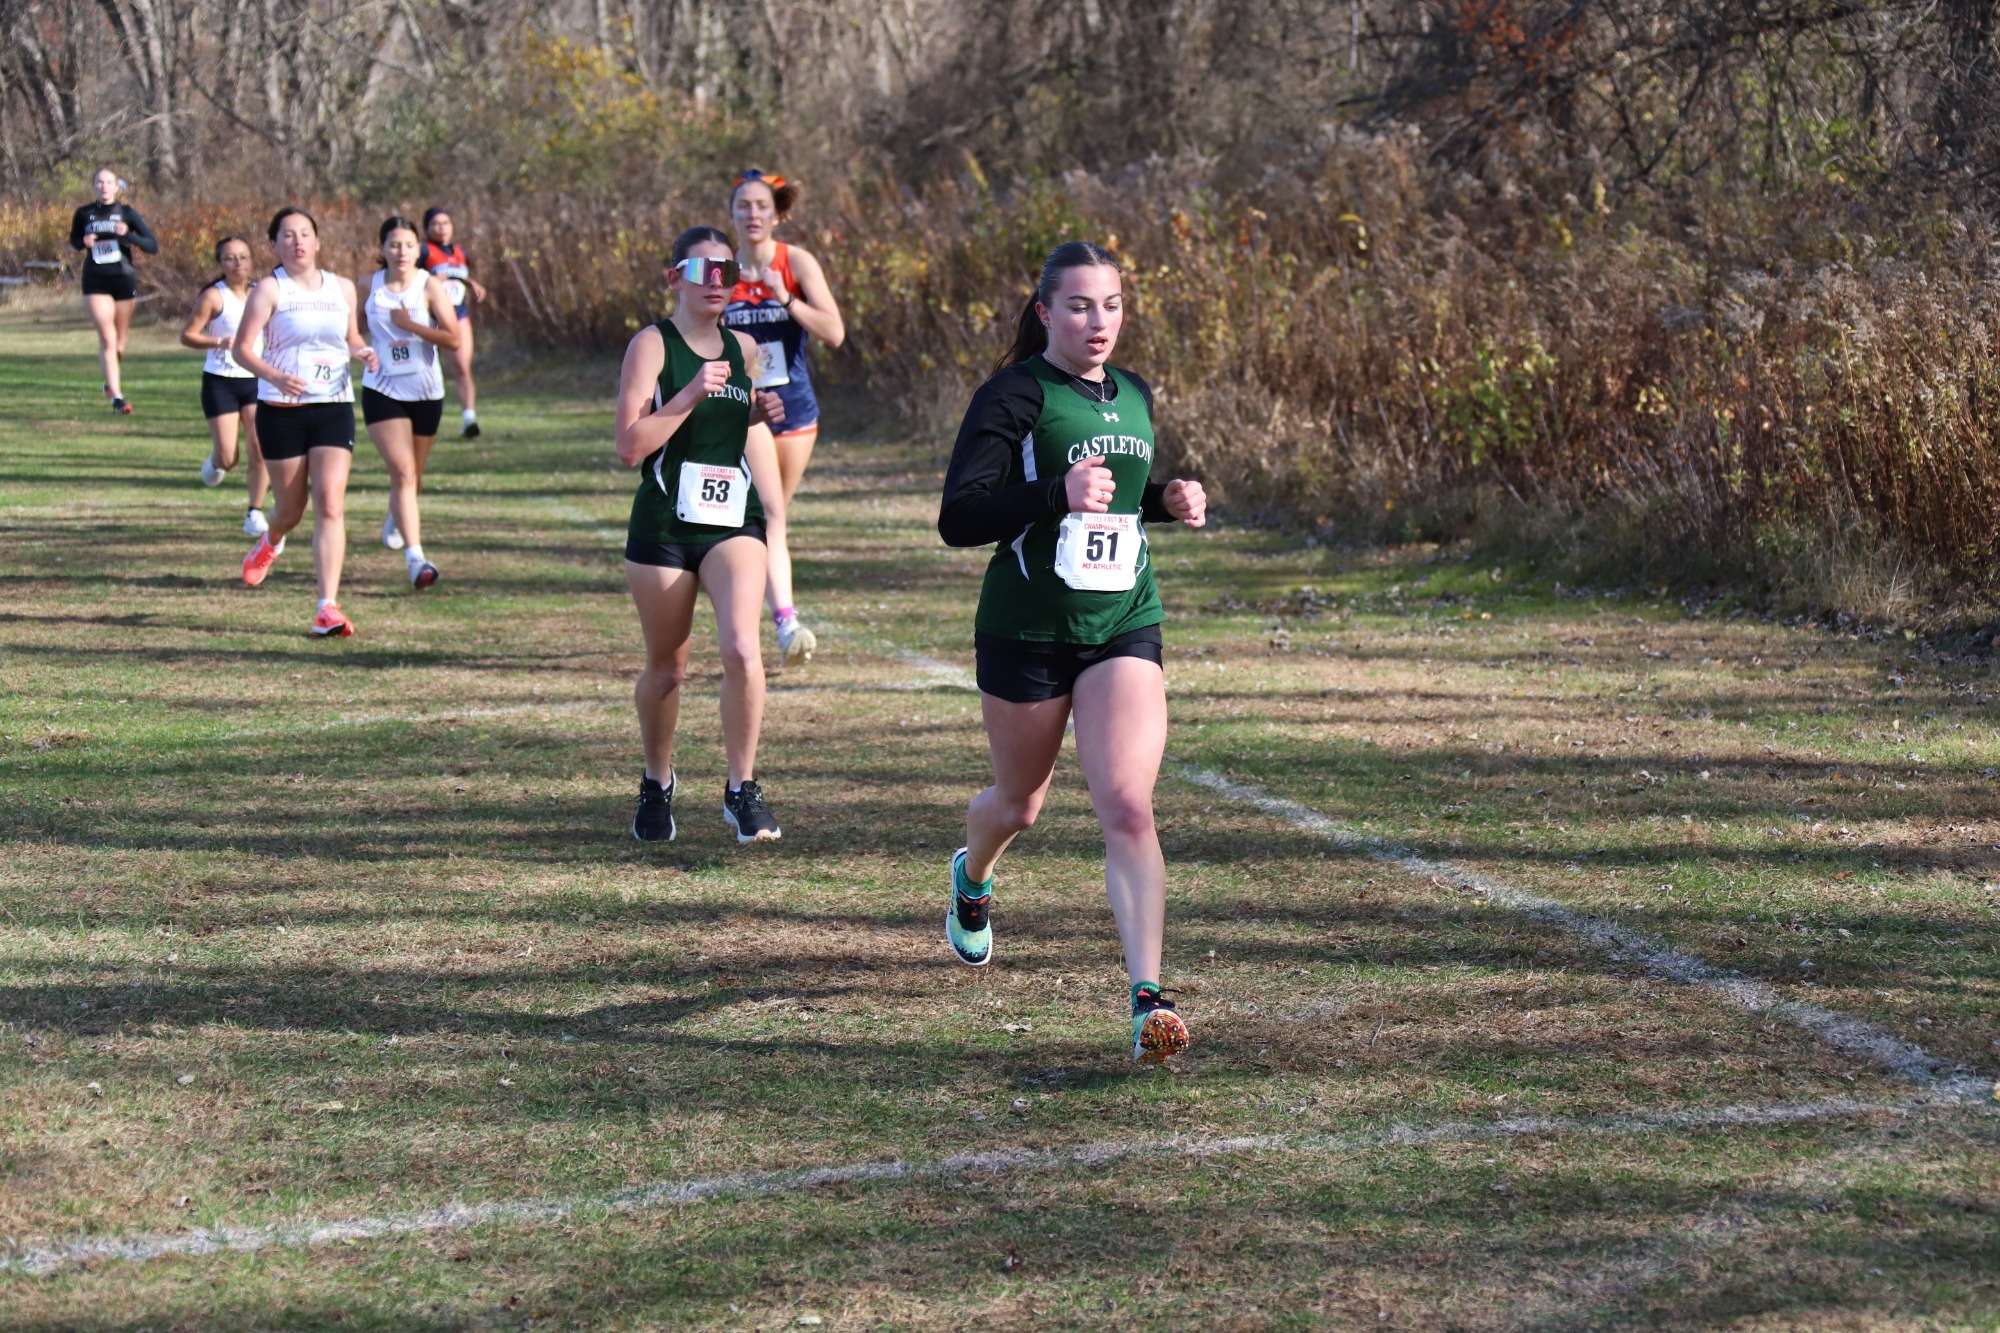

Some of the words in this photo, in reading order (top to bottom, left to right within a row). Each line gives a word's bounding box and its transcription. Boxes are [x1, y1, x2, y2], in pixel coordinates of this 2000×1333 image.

[391, 346, 410, 361] 69
[314, 364, 331, 380] 73
[1067, 435, 1152, 465] CASTLETON
[701, 478, 730, 503] 53
[1085, 515, 1103, 523] LITTLE
[1103, 515, 1118, 523] EAST
[1086, 531, 1119, 562] 51
[1082, 562, 1091, 570] MF
